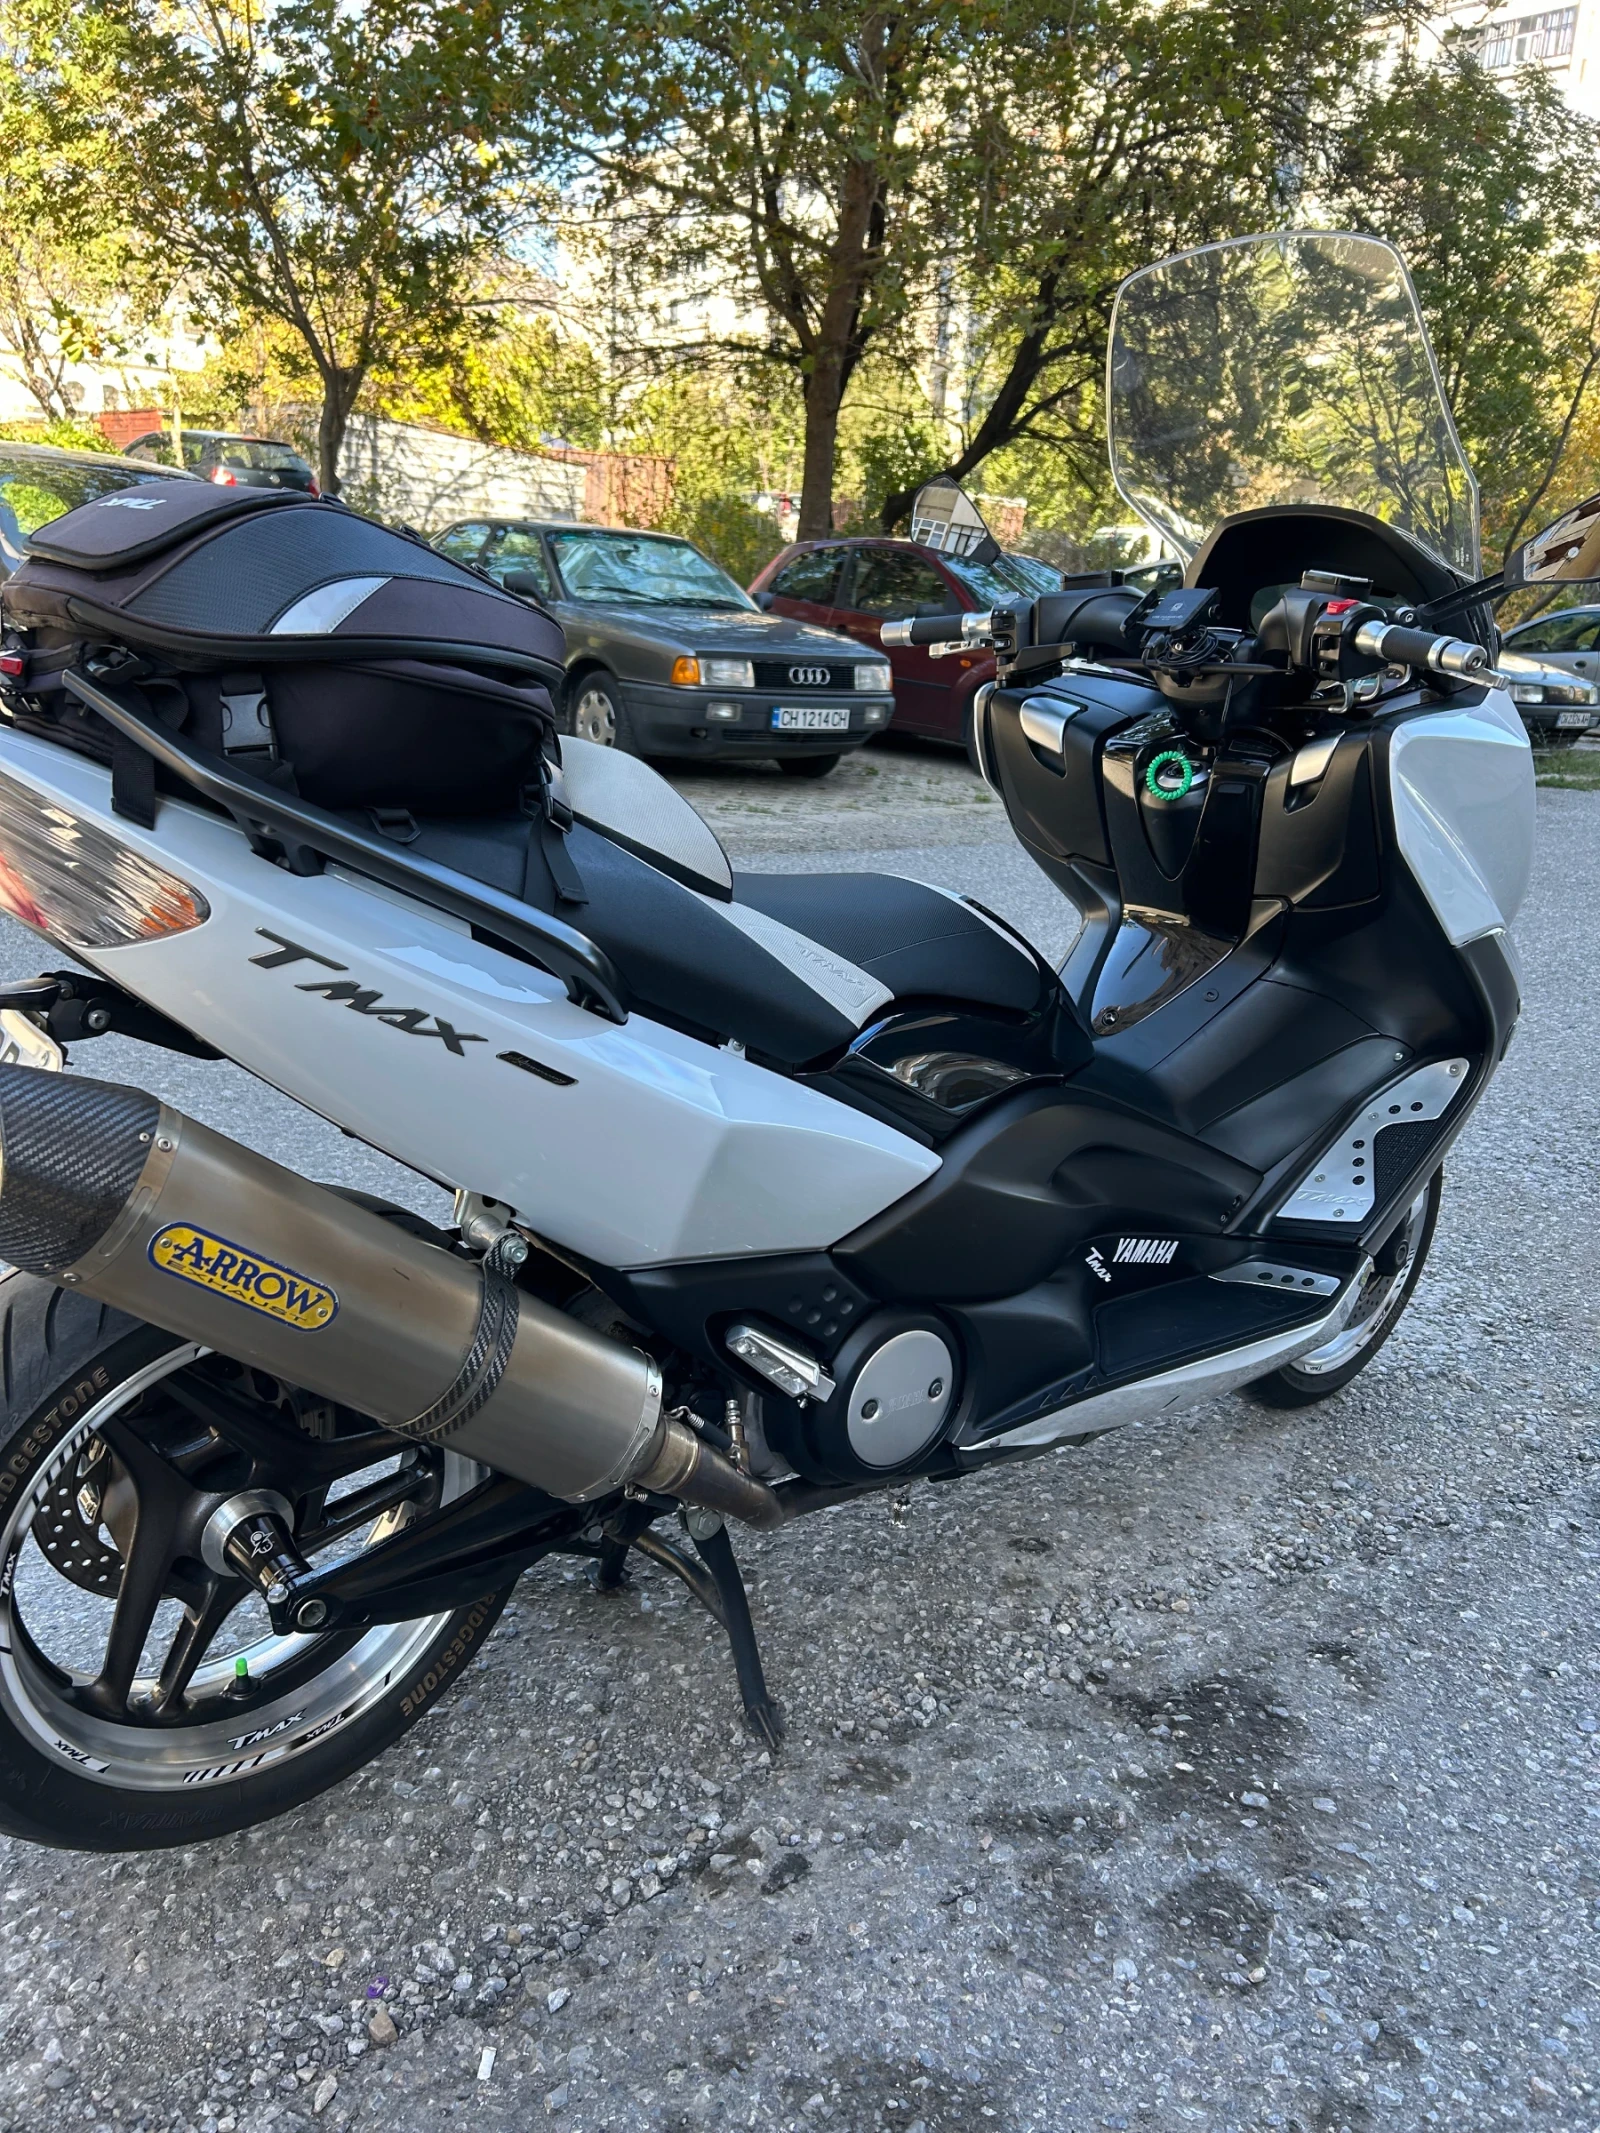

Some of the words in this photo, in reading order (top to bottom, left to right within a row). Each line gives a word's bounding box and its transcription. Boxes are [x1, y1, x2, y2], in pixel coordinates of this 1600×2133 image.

[248, 926, 489, 1057] TMAX
[171, 1236, 327, 1315] ARROW
[1111, 1237, 1180, 1264] YAMAHA
[165, 1259, 308, 1323] EXHAUST
[227, 1708, 307, 1751] TMAX
